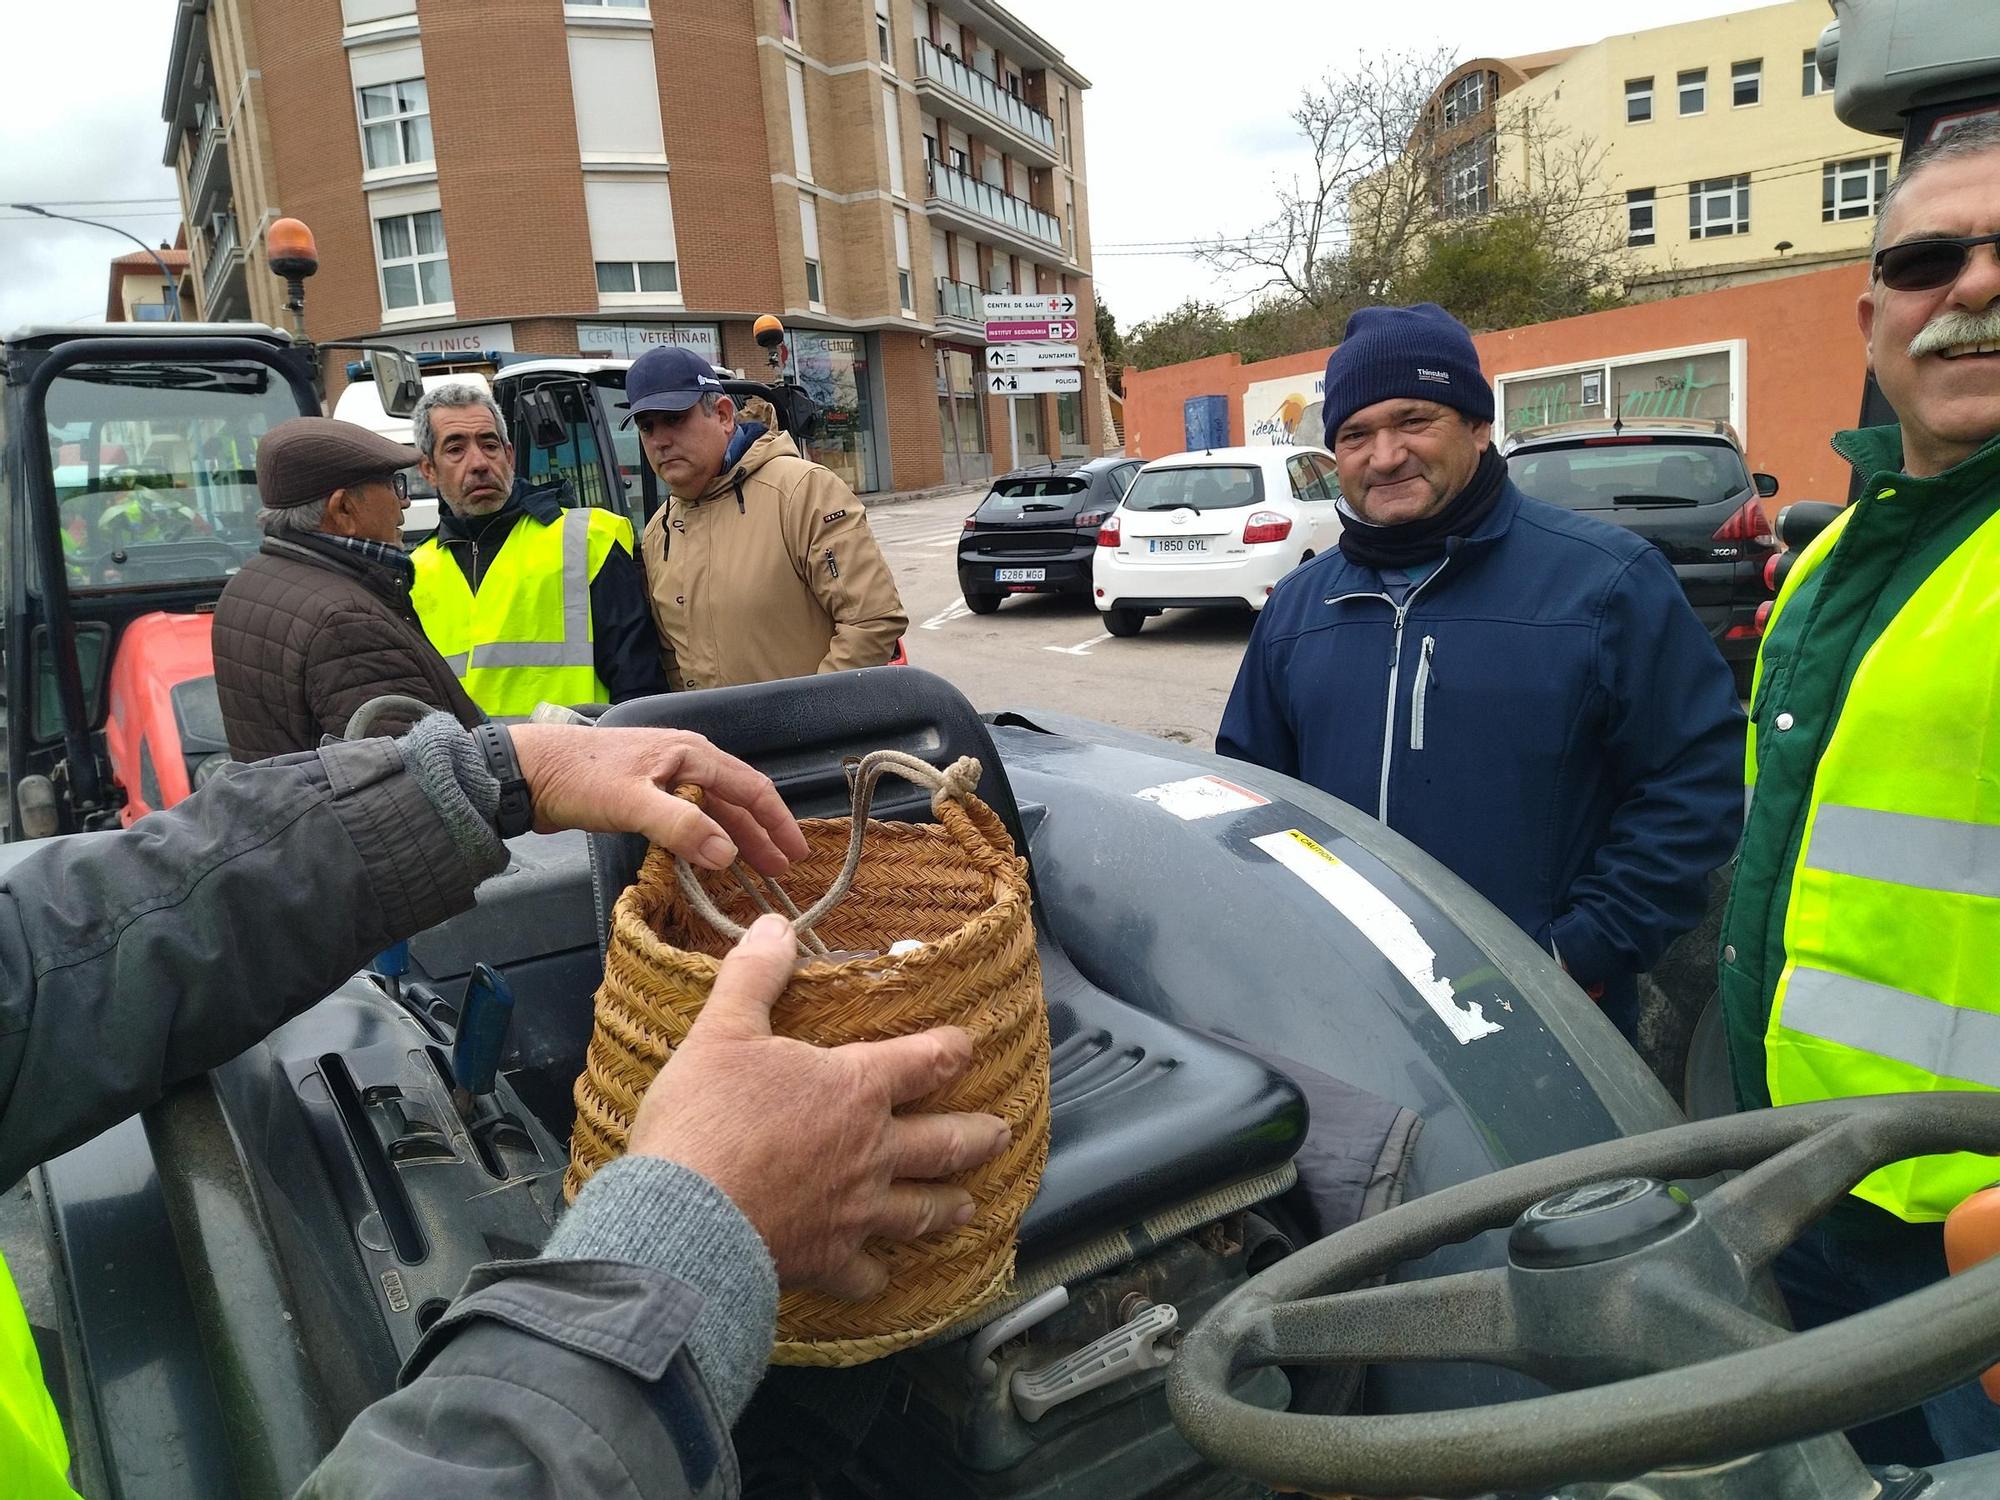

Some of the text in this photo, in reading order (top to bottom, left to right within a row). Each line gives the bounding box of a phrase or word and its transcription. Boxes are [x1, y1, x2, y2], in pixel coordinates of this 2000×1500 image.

[587, 331, 712, 344] CENTRE VETERINARI
[1159, 540, 1207, 552] 1850 GYL
[1001, 569, 1043, 580] 5286 MGG
[1300, 838, 1335, 861] CAUTION
